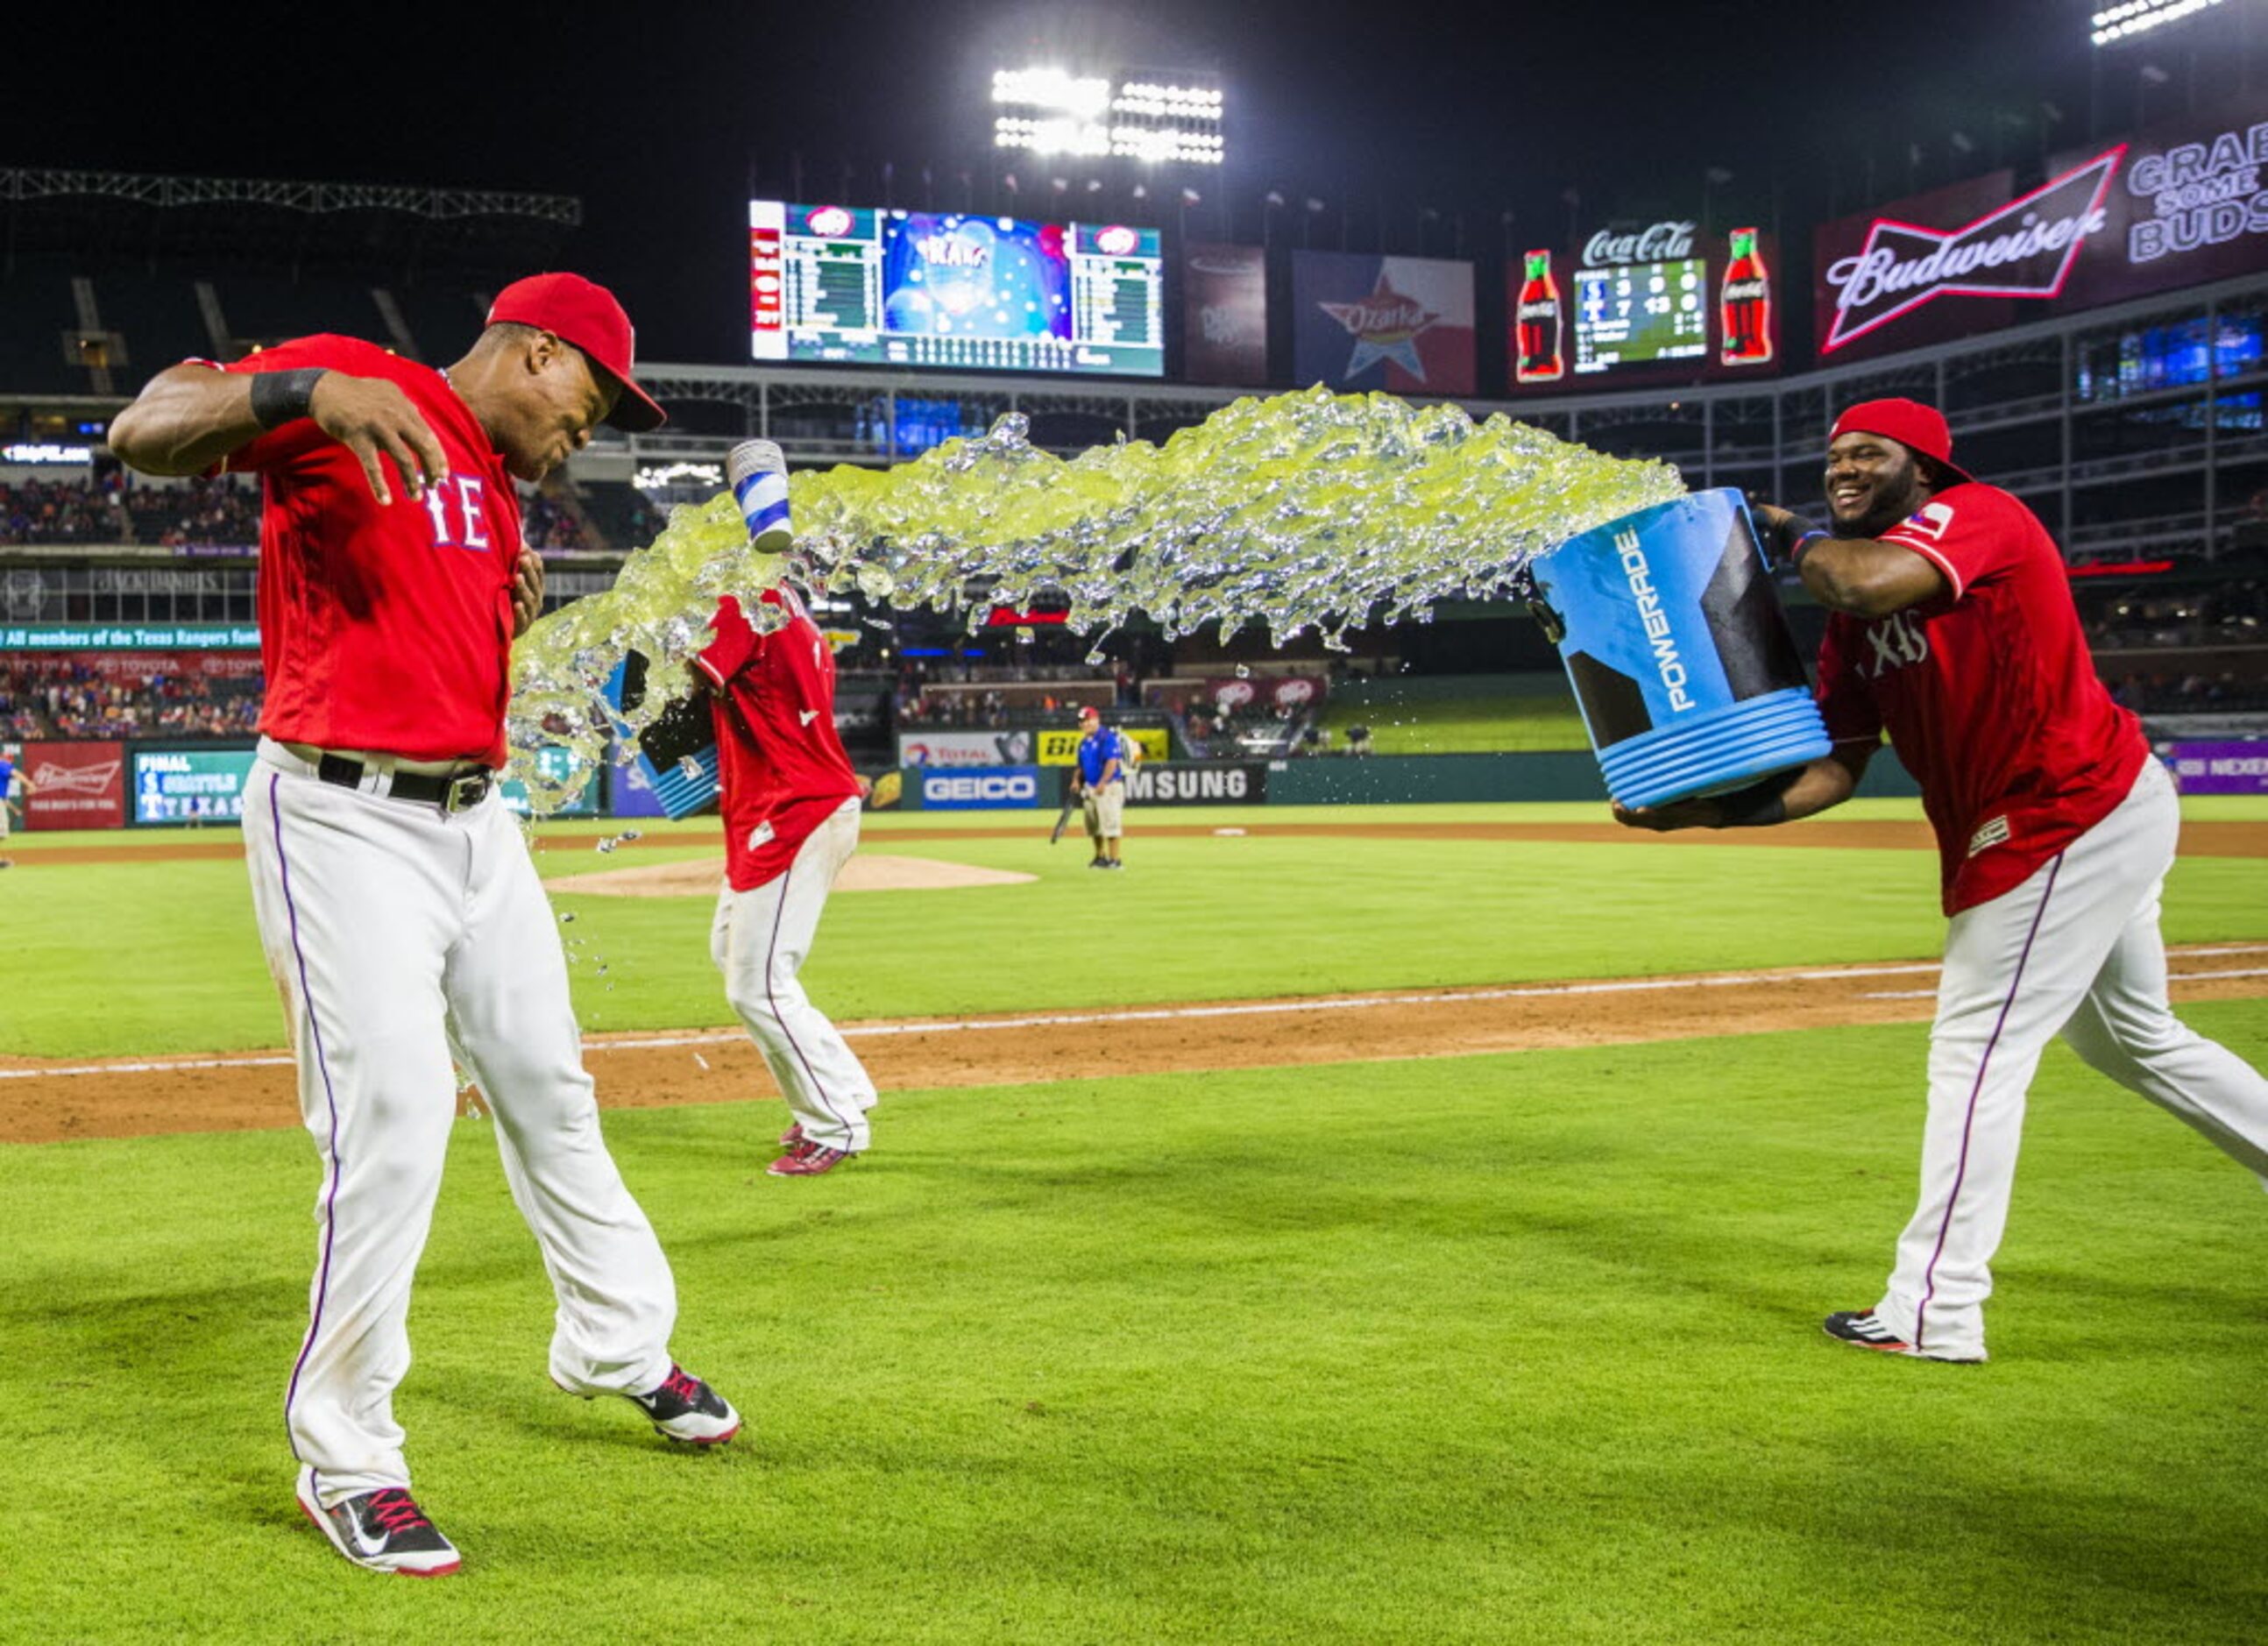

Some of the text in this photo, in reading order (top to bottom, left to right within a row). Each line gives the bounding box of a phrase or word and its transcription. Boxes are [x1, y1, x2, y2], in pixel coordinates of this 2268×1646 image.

[2154, 167, 2260, 217] SOME
[1826, 208, 2106, 309] Budweiser
[1616, 299, 1632, 317] 7
[1613, 528, 1697, 713] POWERADE
[7, 629, 25, 645] All
[29, 629, 89, 645] members
[93, 629, 108, 645] of
[110, 629, 132, 645] the
[135, 629, 173, 645] Texas
[177, 629, 229, 648] Rangers
[1854, 608, 1927, 678] XAS
[122, 660, 180, 672] TOYOTA
[138, 756, 191, 771] FINAL
[936, 748, 991, 760] TOTAL
[925, 776, 1035, 800] GEICO
[1124, 770, 1247, 799] MSUNG
[164, 795, 244, 815] TEXAS
